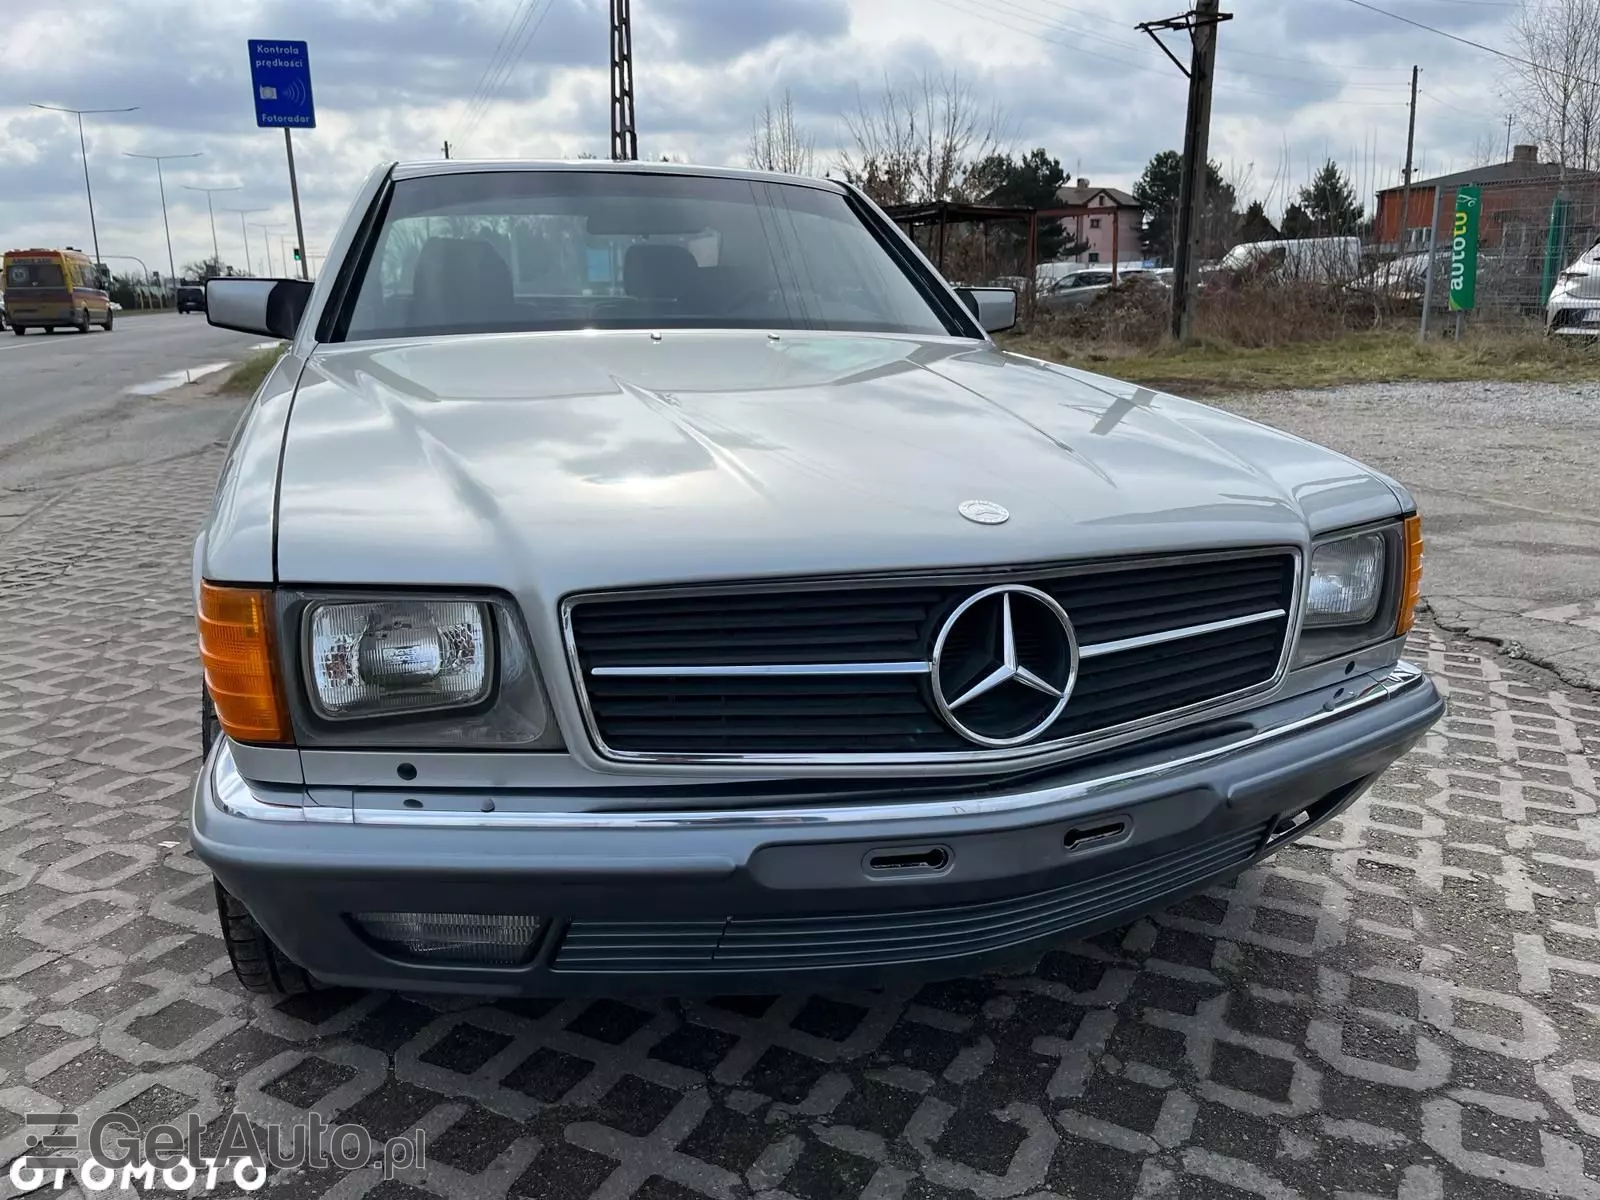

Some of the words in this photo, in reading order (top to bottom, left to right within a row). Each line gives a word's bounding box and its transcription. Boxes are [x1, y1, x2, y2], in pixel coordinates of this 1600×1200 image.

[257, 44, 299, 54] Kontrola
[262, 113, 310, 123] Fotoradar
[1450, 211, 1468, 291] autotu
